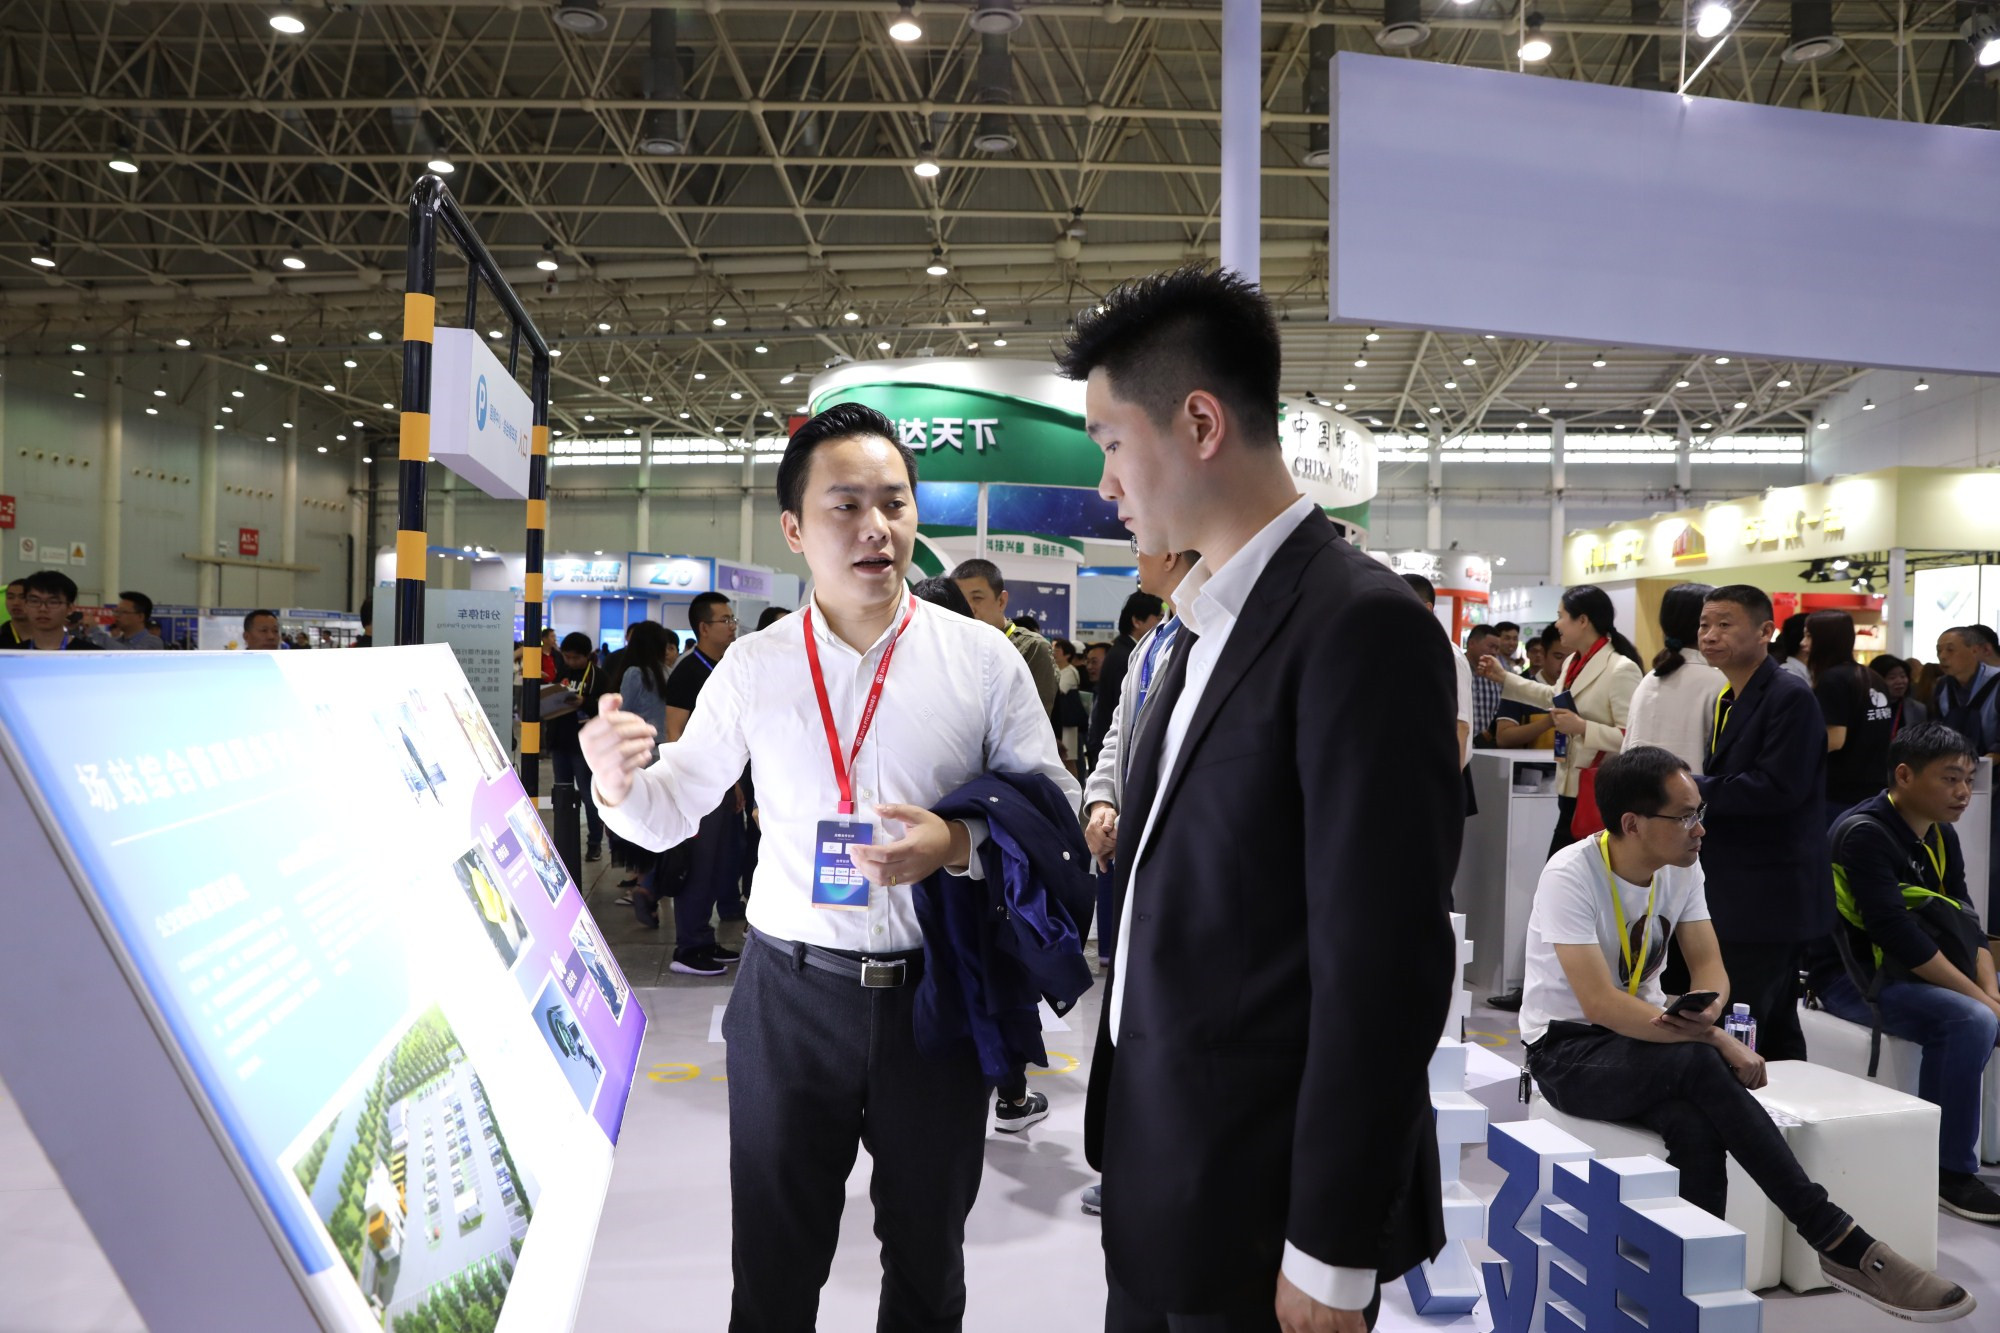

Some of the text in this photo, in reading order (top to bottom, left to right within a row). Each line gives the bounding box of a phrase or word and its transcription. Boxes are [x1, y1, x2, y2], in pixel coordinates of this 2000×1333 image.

[893, 417, 998, 450] 达天下
[1294, 456, 1333, 481] CHINA
